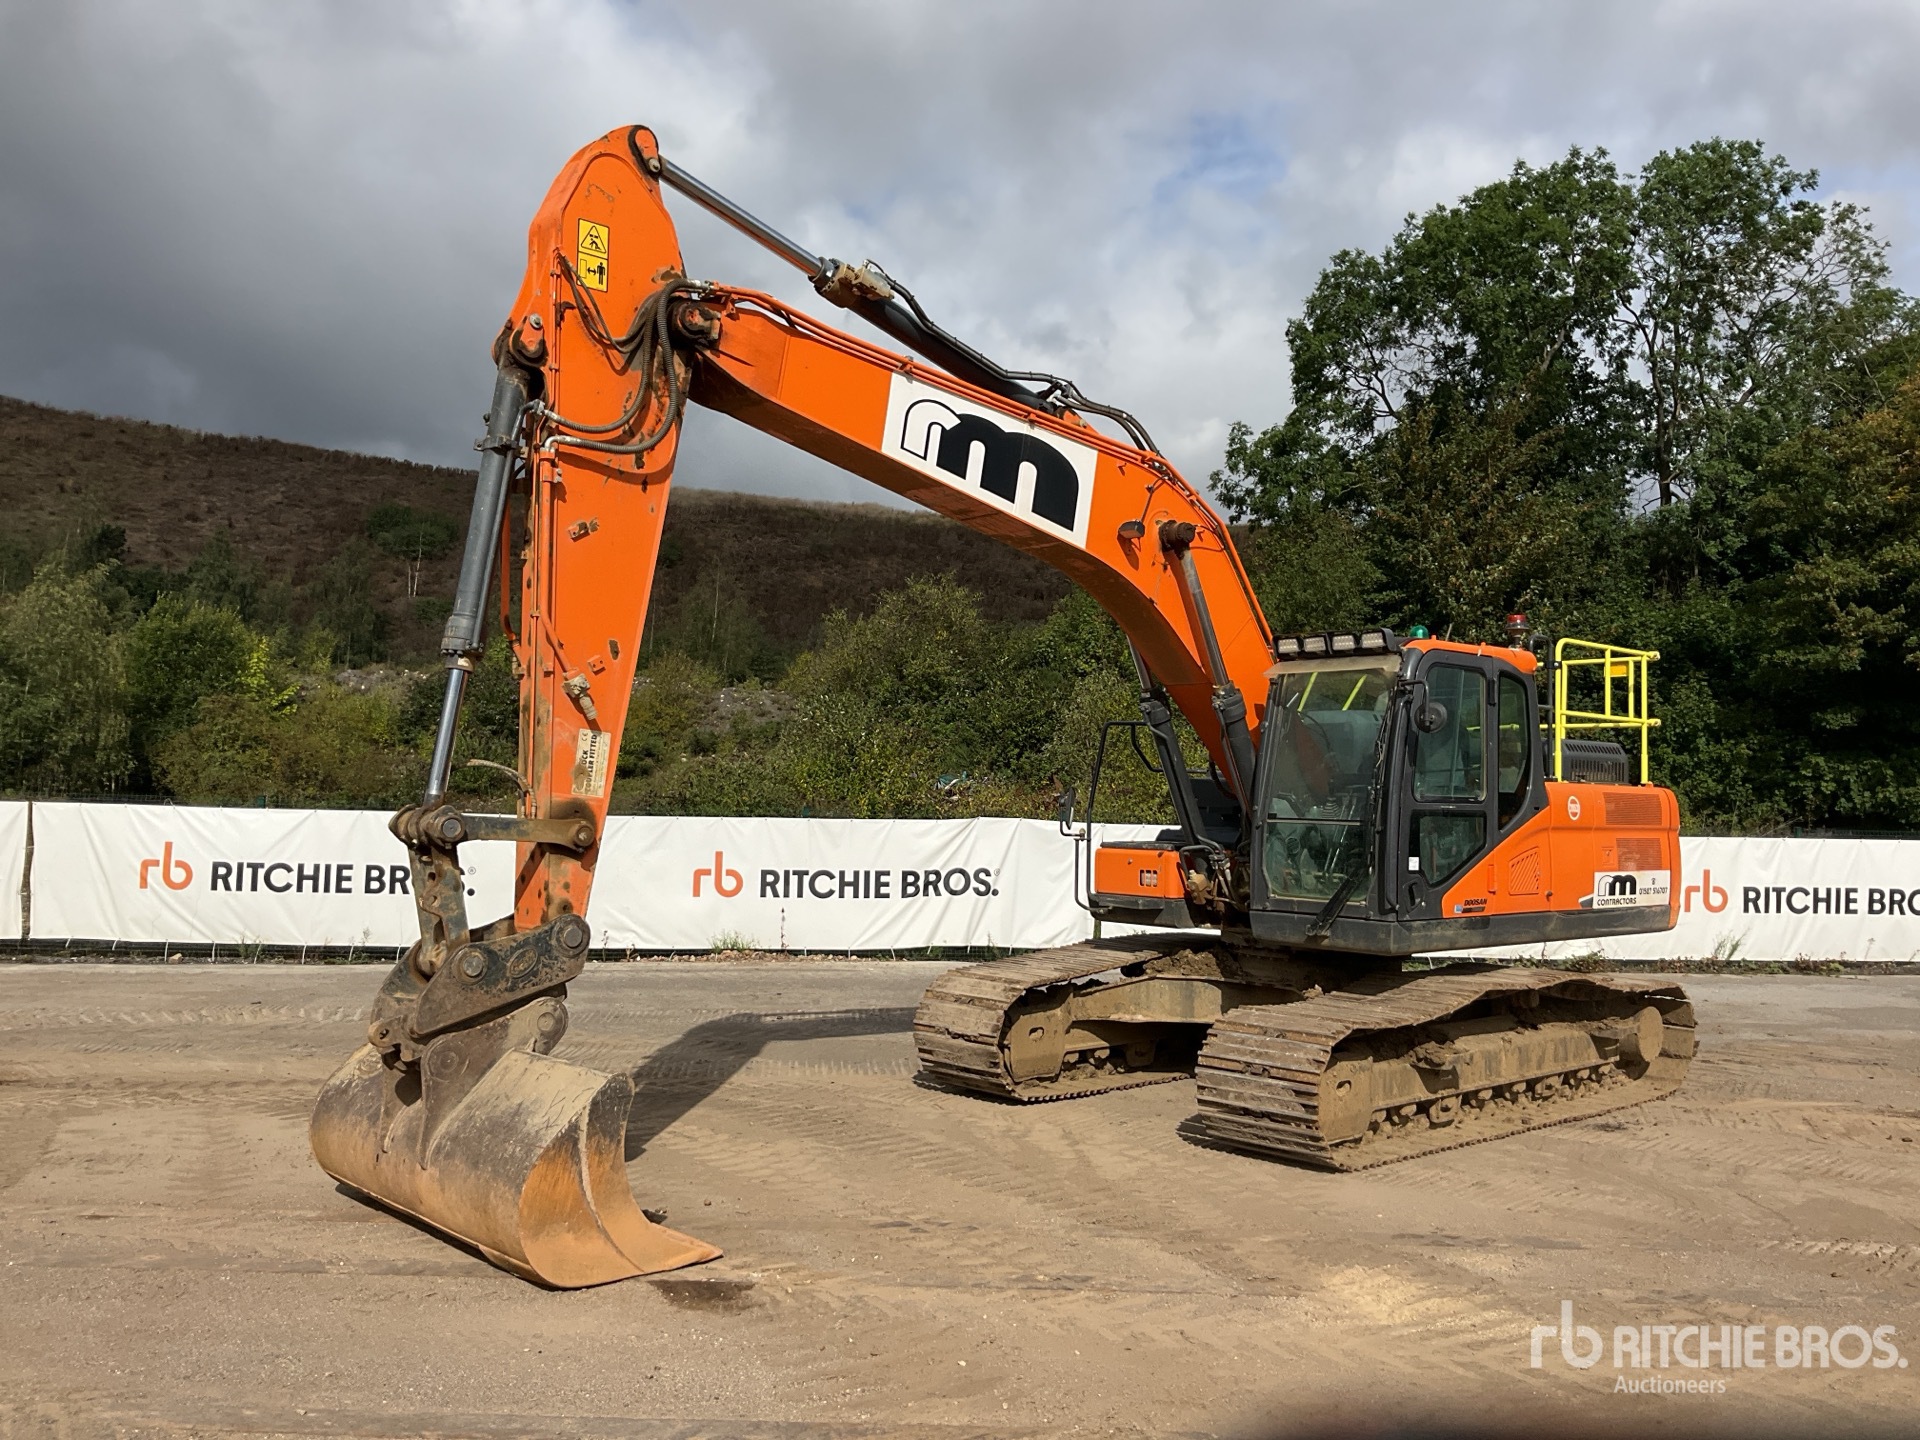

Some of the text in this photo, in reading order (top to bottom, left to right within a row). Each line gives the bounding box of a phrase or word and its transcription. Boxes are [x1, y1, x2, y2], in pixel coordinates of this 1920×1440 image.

[589, 734, 598, 759] FITTED
[139, 841, 194, 890] rb
[210, 862, 353, 893] RITCHIE
[692, 851, 744, 898] rb
[760, 868, 891, 899] RITCHIE
[1597, 897, 1637, 906] CONTRACTORS
[1684, 869, 1729, 913] rb
[1743, 886, 1857, 915] RITCHIE
